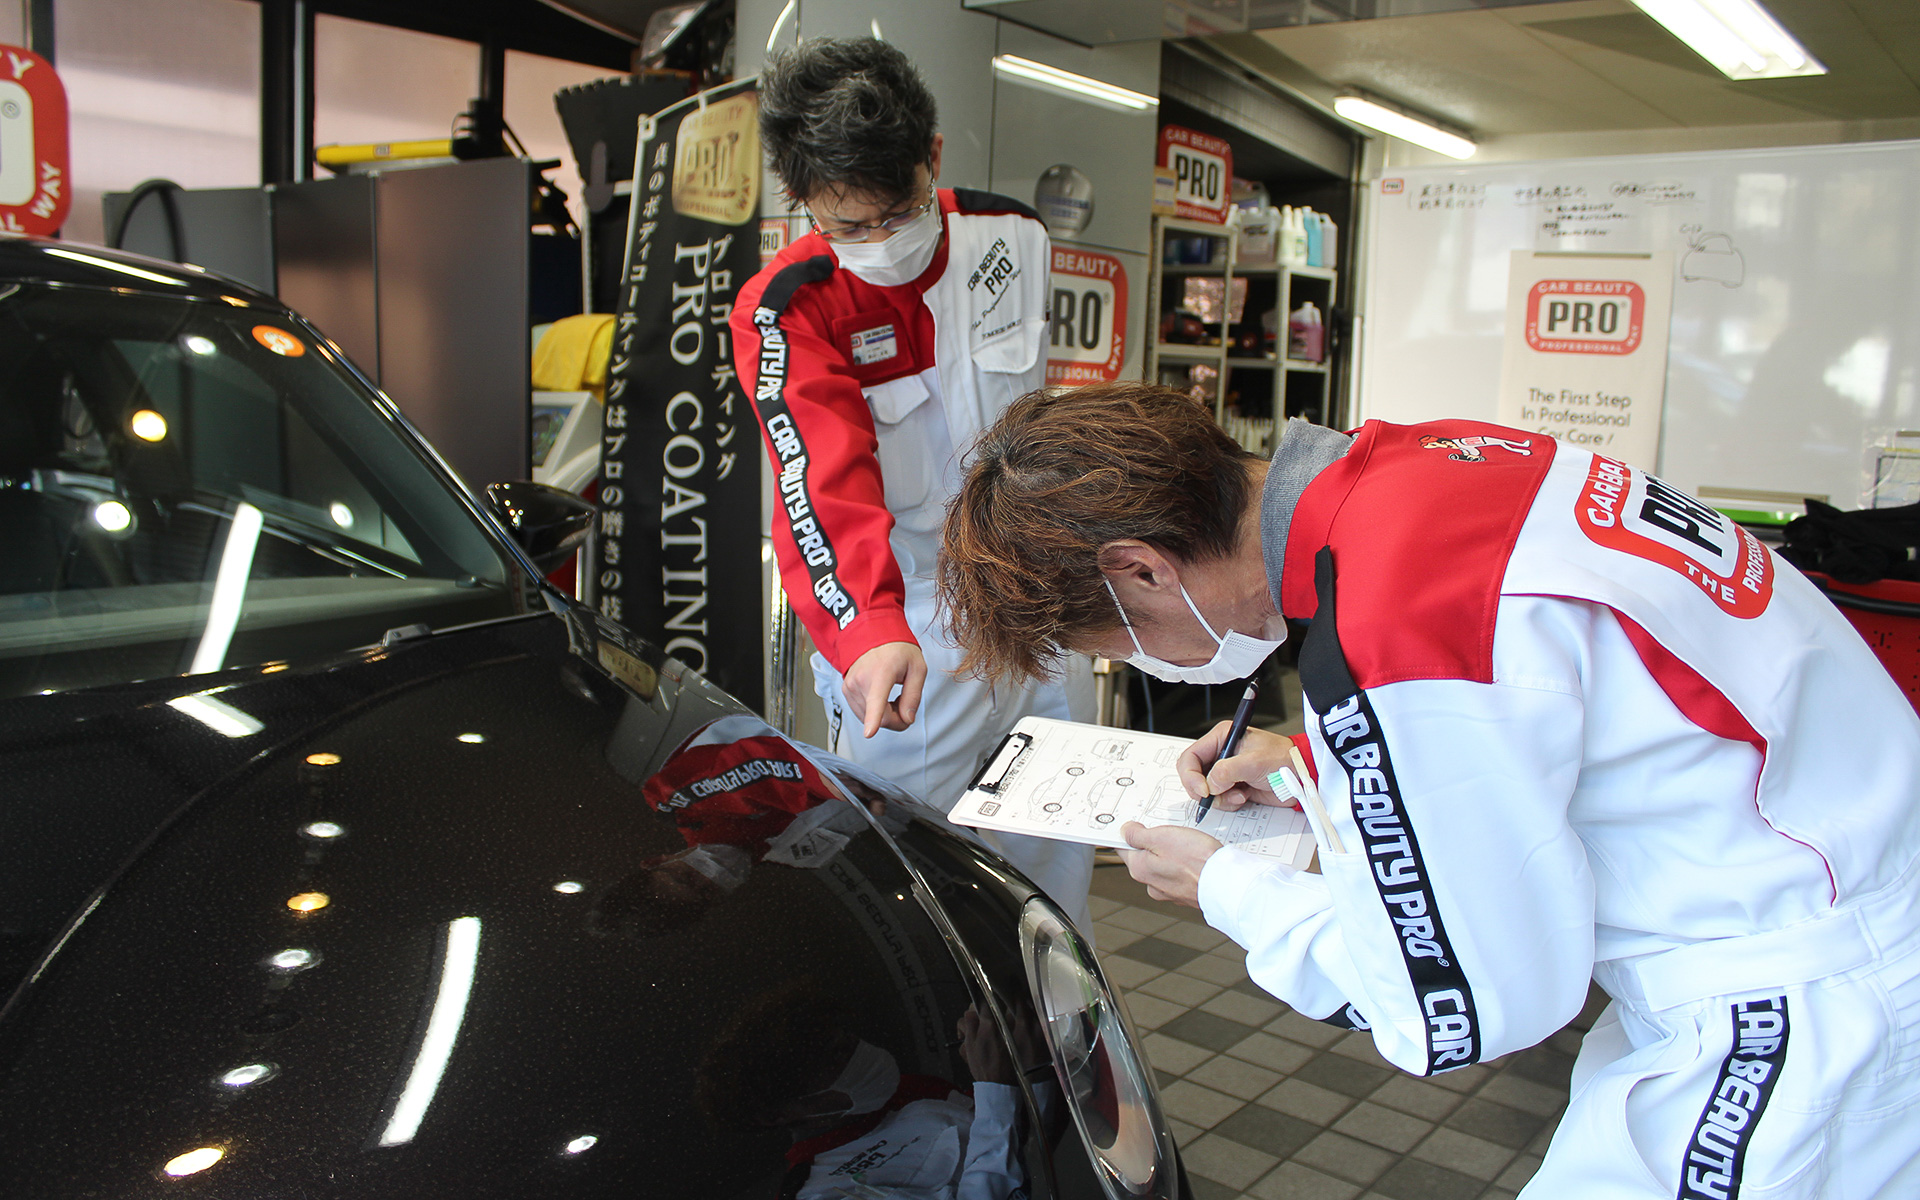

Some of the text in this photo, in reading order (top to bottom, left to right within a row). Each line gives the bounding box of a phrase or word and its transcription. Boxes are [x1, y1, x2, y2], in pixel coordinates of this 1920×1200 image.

[1165, 128, 1231, 156] CAR BEAUTY
[30, 160, 62, 219] WAY
[1175, 151, 1219, 202] PRO
[760, 232, 779, 250] RO
[967, 238, 1006, 292] CAR BEAUTY
[984, 256, 1014, 296] PRO
[1054, 251, 1119, 278] BEAUTY
[670, 237, 712, 366] PRO
[1537, 281, 1635, 295] CAR BEAUTY
[1051, 287, 1103, 350] RO
[1547, 300, 1619, 334] PRO
[711, 233, 736, 481] プロコーティング
[1107, 333, 1123, 372] WAY
[1047, 366, 1106, 382] ESSIONAL
[1520, 405, 1631, 427] In Professional
[1528, 387, 1631, 410] The First Step
[1567, 428, 1604, 445] Care
[767, 413, 801, 461] CAR
[793, 516, 831, 567] PRO
[1587, 481, 1622, 528] CAR
[1684, 560, 1737, 604] THE
[1340, 741, 1420, 887] BEAUTY
[1384, 890, 1445, 960] PRO
[1423, 987, 1473, 1068] CAR
[1686, 1057, 1773, 1200] BEAUTY
